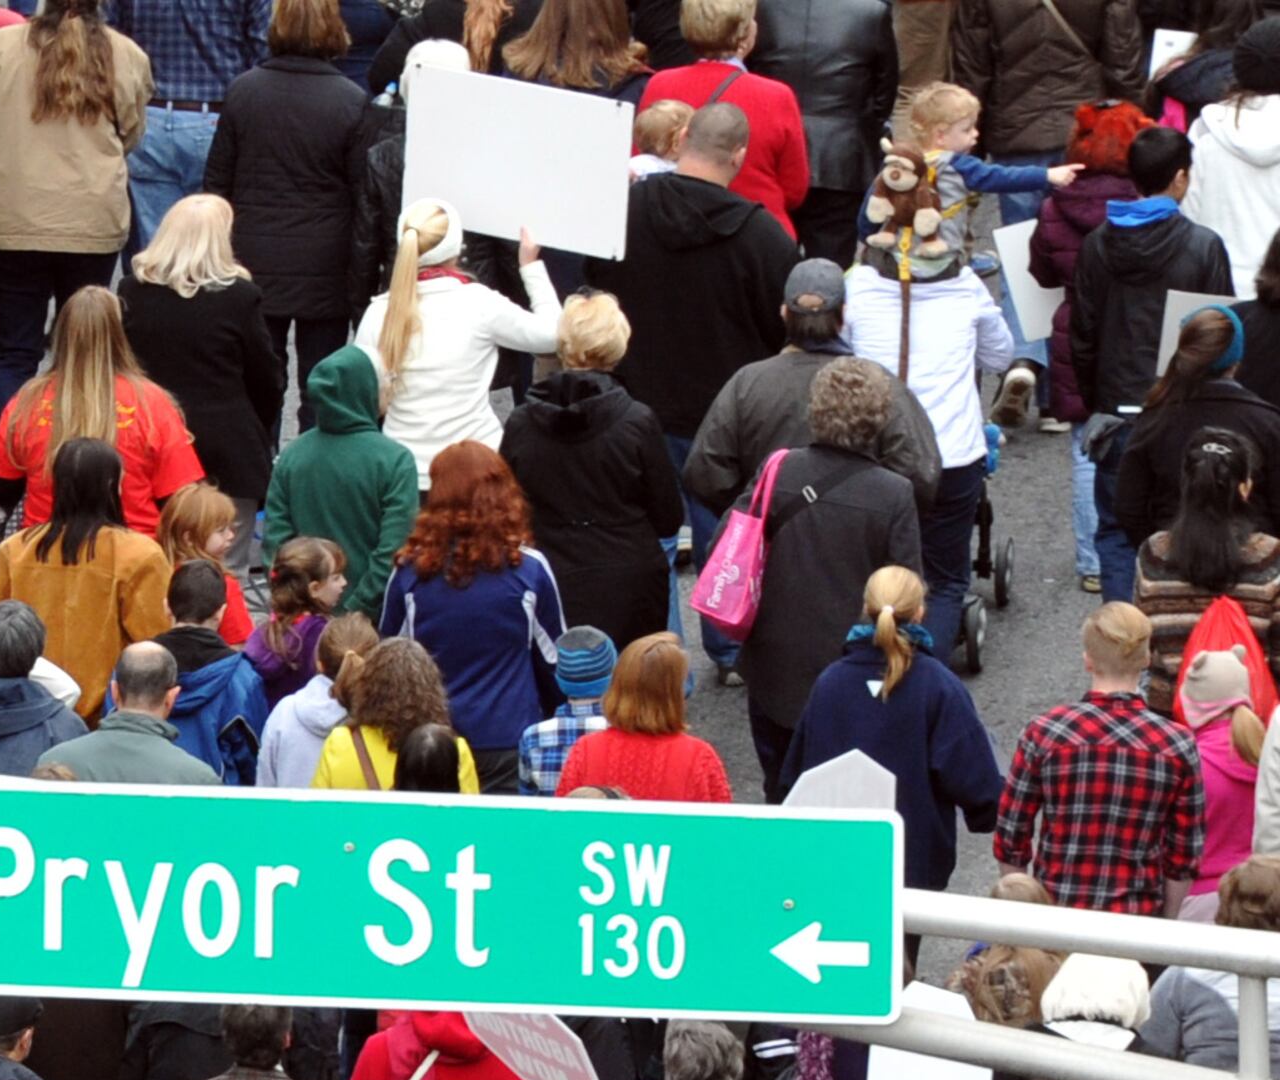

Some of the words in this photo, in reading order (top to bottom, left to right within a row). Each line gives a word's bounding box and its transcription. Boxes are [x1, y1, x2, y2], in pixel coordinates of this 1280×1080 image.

[363, 837, 492, 968] St
[578, 840, 672, 907] SW
[578, 913, 687, 981] 130
